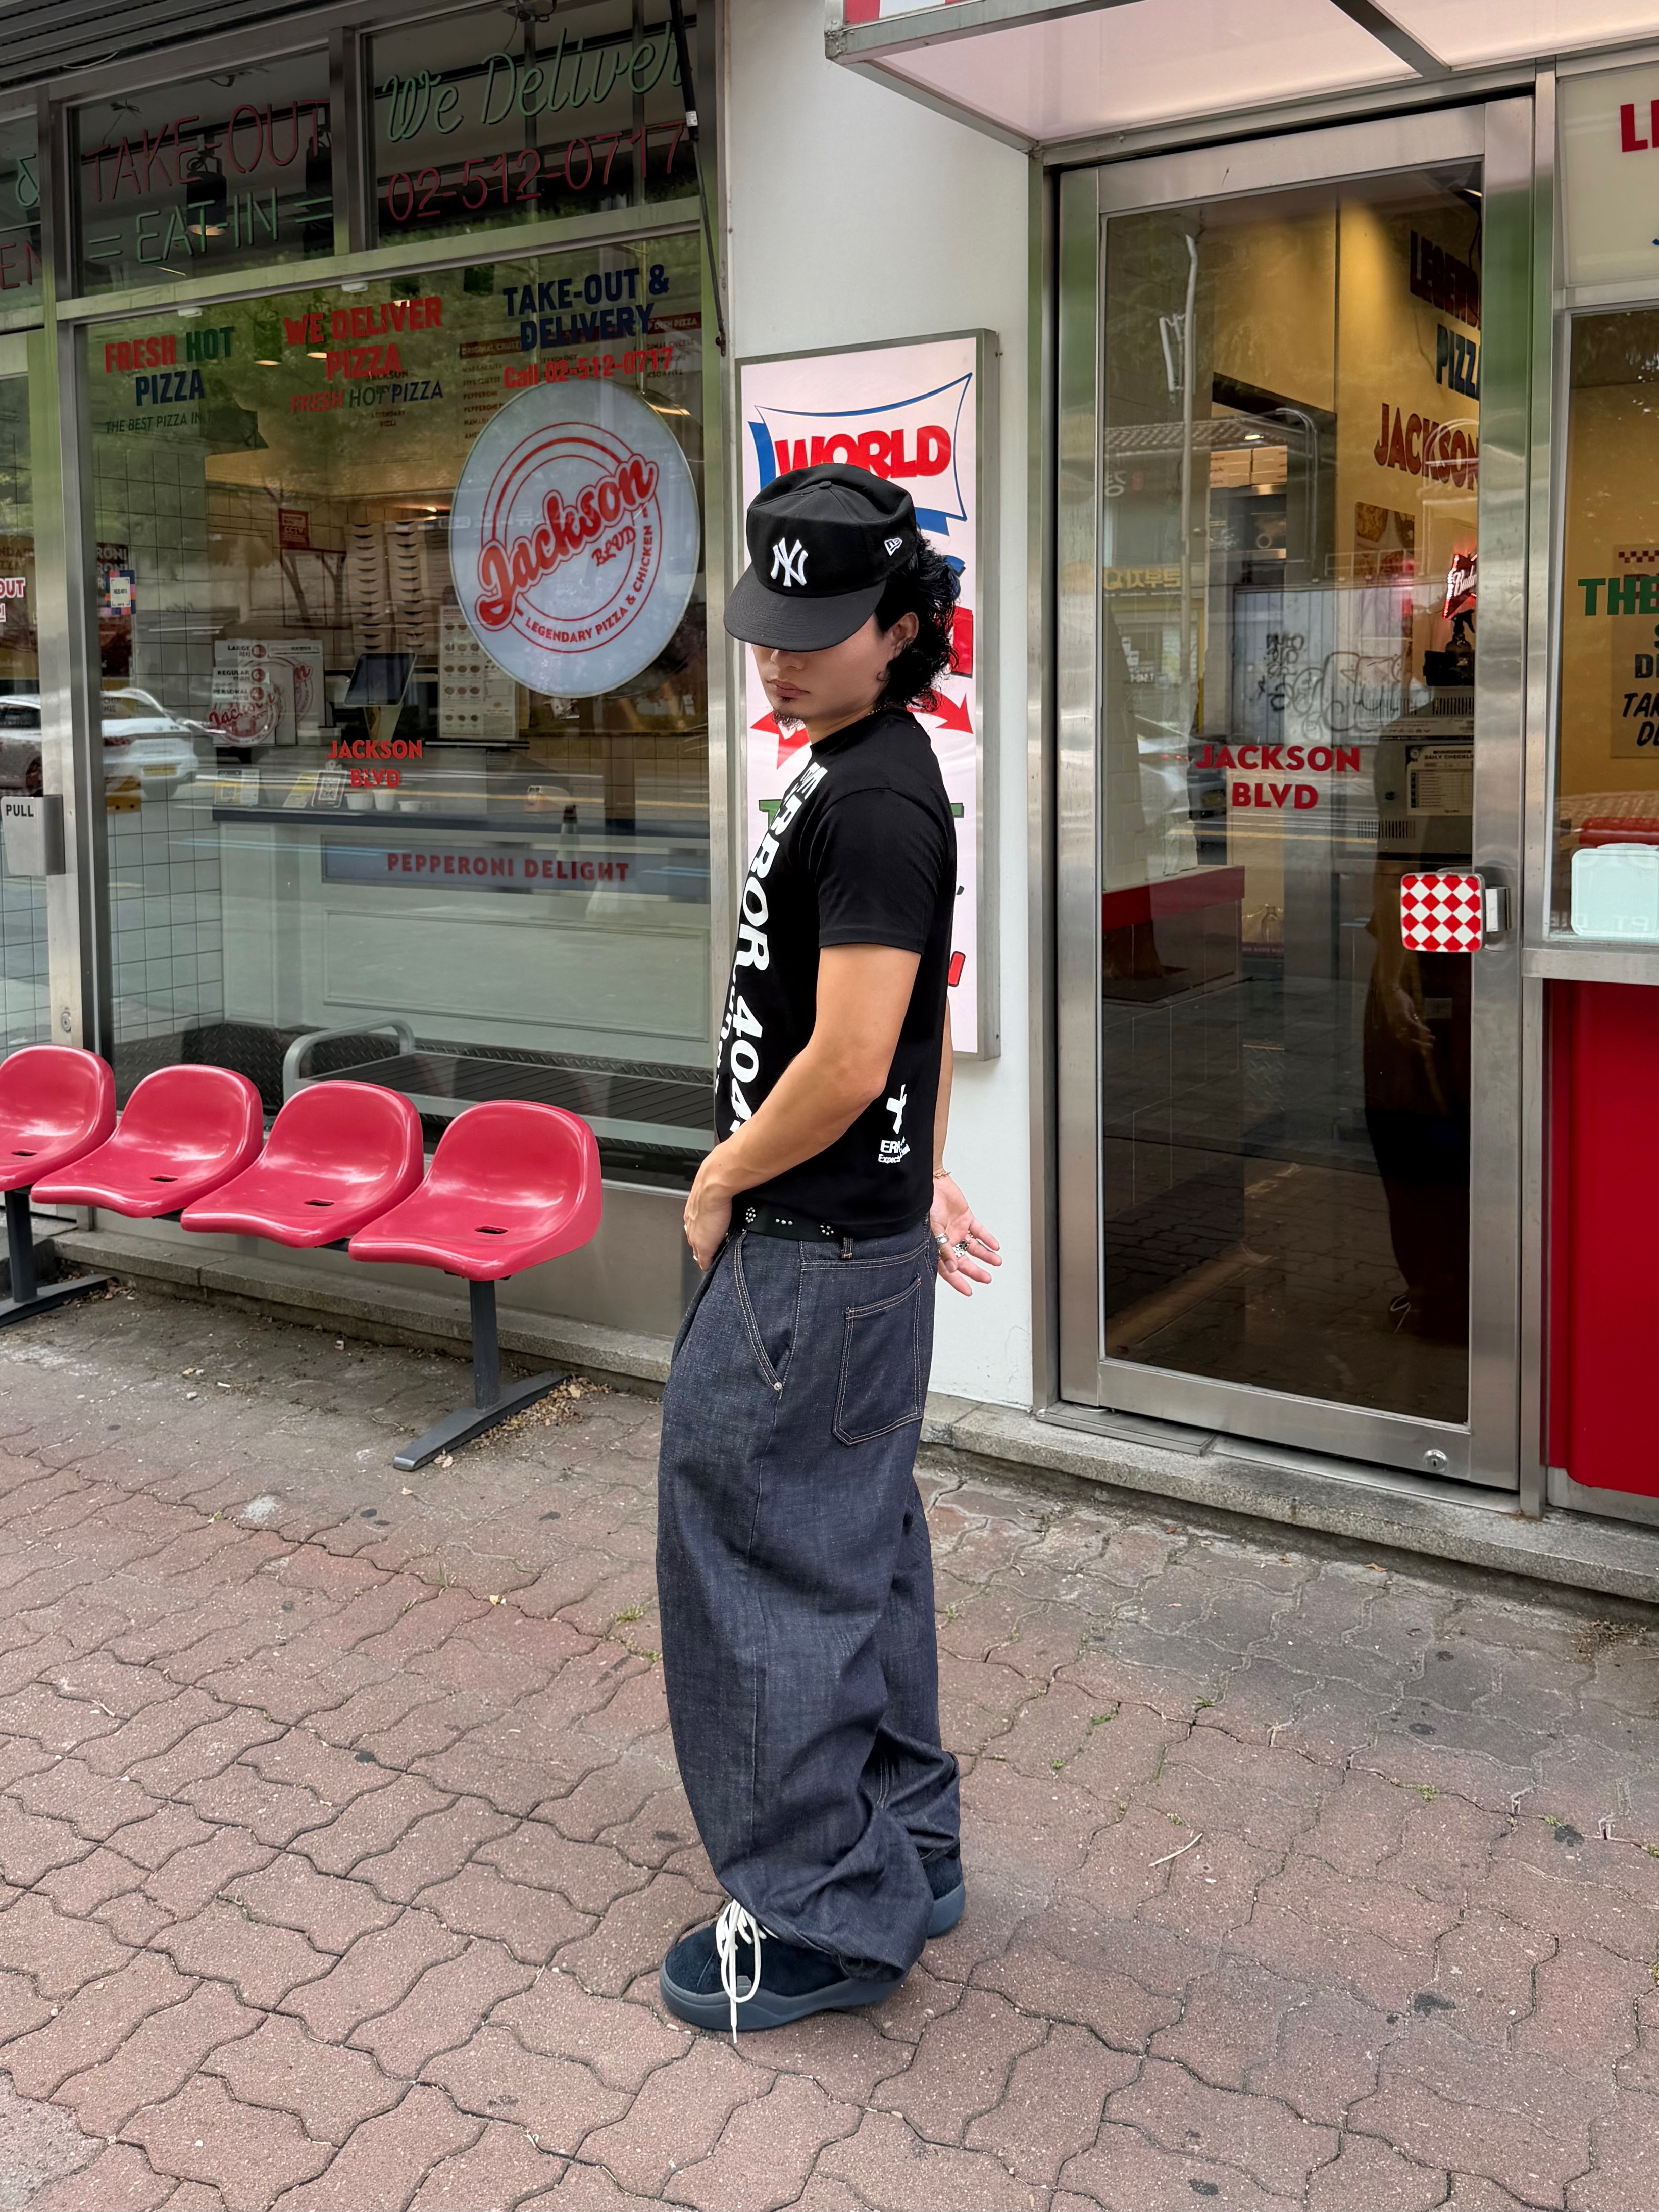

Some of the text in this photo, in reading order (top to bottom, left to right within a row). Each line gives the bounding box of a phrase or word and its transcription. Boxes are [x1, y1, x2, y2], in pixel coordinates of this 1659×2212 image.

[382, 20, 682, 142] We Deliver
[84, 99, 331, 202] TAKE-OUT
[387, 120, 689, 221] 02-512-0717
[136, 187, 278, 264] EAT IN
[503, 264, 670, 317] TAKE-OUT &
[284, 296, 442, 346] WE DELIVER
[520, 303, 655, 351] DELIVERY
[105, 326, 235, 374] FRESH HOT
[326, 343, 403, 381] PIZZA
[504, 346, 673, 389] Call 02-512-0717
[1437, 323, 1481, 401] PIZZ
[135, 369, 205, 406] PIZZA
[289, 390, 344, 415] FRESH
[349, 385, 386, 408] HOT
[391, 380, 443, 404] PIZZA
[105, 420, 125, 434] THE
[128, 417, 153, 431] BEST
[156, 413, 187, 428] PIZZA
[1374, 403, 1479, 491] JACKSON
[775, 425, 951, 480] WORLD
[477, 457, 657, 629] Jackson
[591, 526, 636, 567] BLVD
[525, 524, 653, 643] LEGENDARY PIZZA & CHICKEN
[327, 739, 423, 759] JACKSON
[1195, 745, 1360, 772] JACKSON
[349, 768, 401, 788] BLVD
[1232, 782, 1319, 810] BLVD
[6, 804, 34, 817] PULL
[387, 853, 630, 882] PEPPERONI DELIGHT
